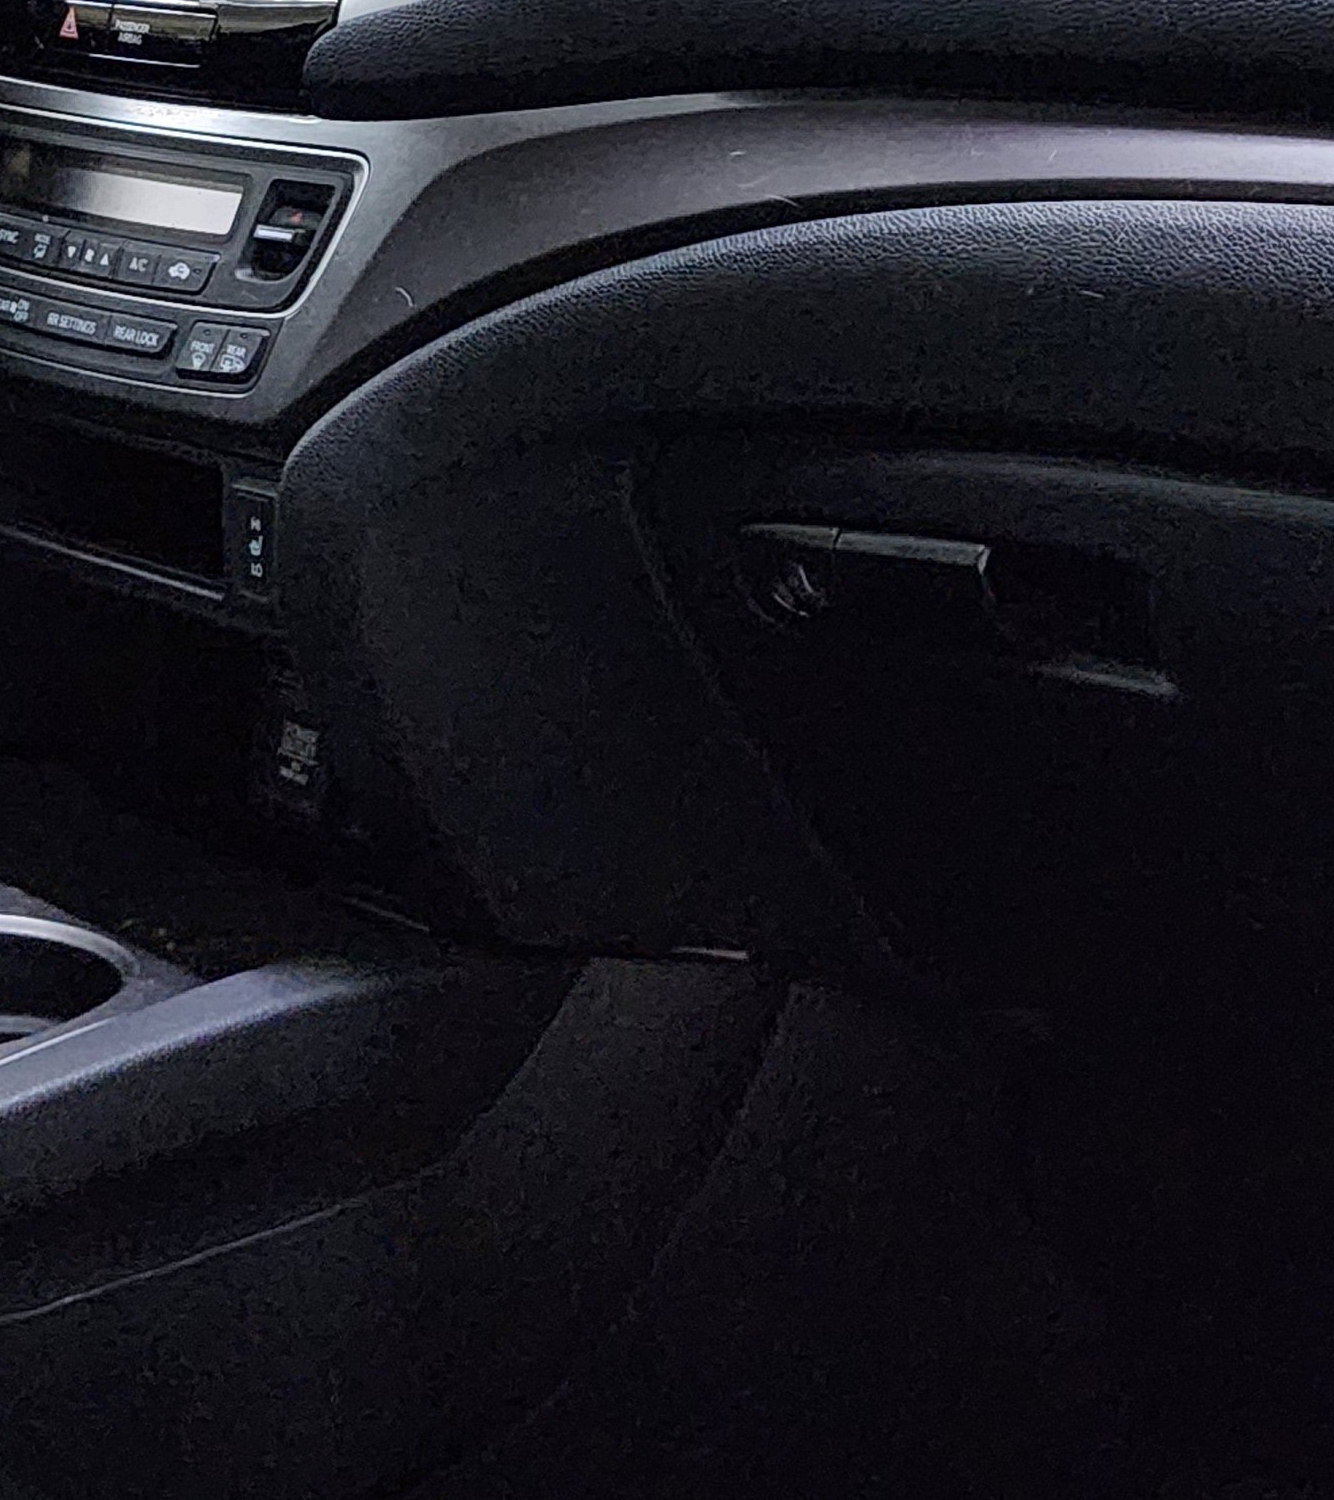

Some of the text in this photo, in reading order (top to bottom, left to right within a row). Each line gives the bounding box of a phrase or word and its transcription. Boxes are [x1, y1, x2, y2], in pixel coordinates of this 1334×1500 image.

[58, 314, 97, 335] SETTINGS
[113, 325, 159, 347] REAR LOCK
